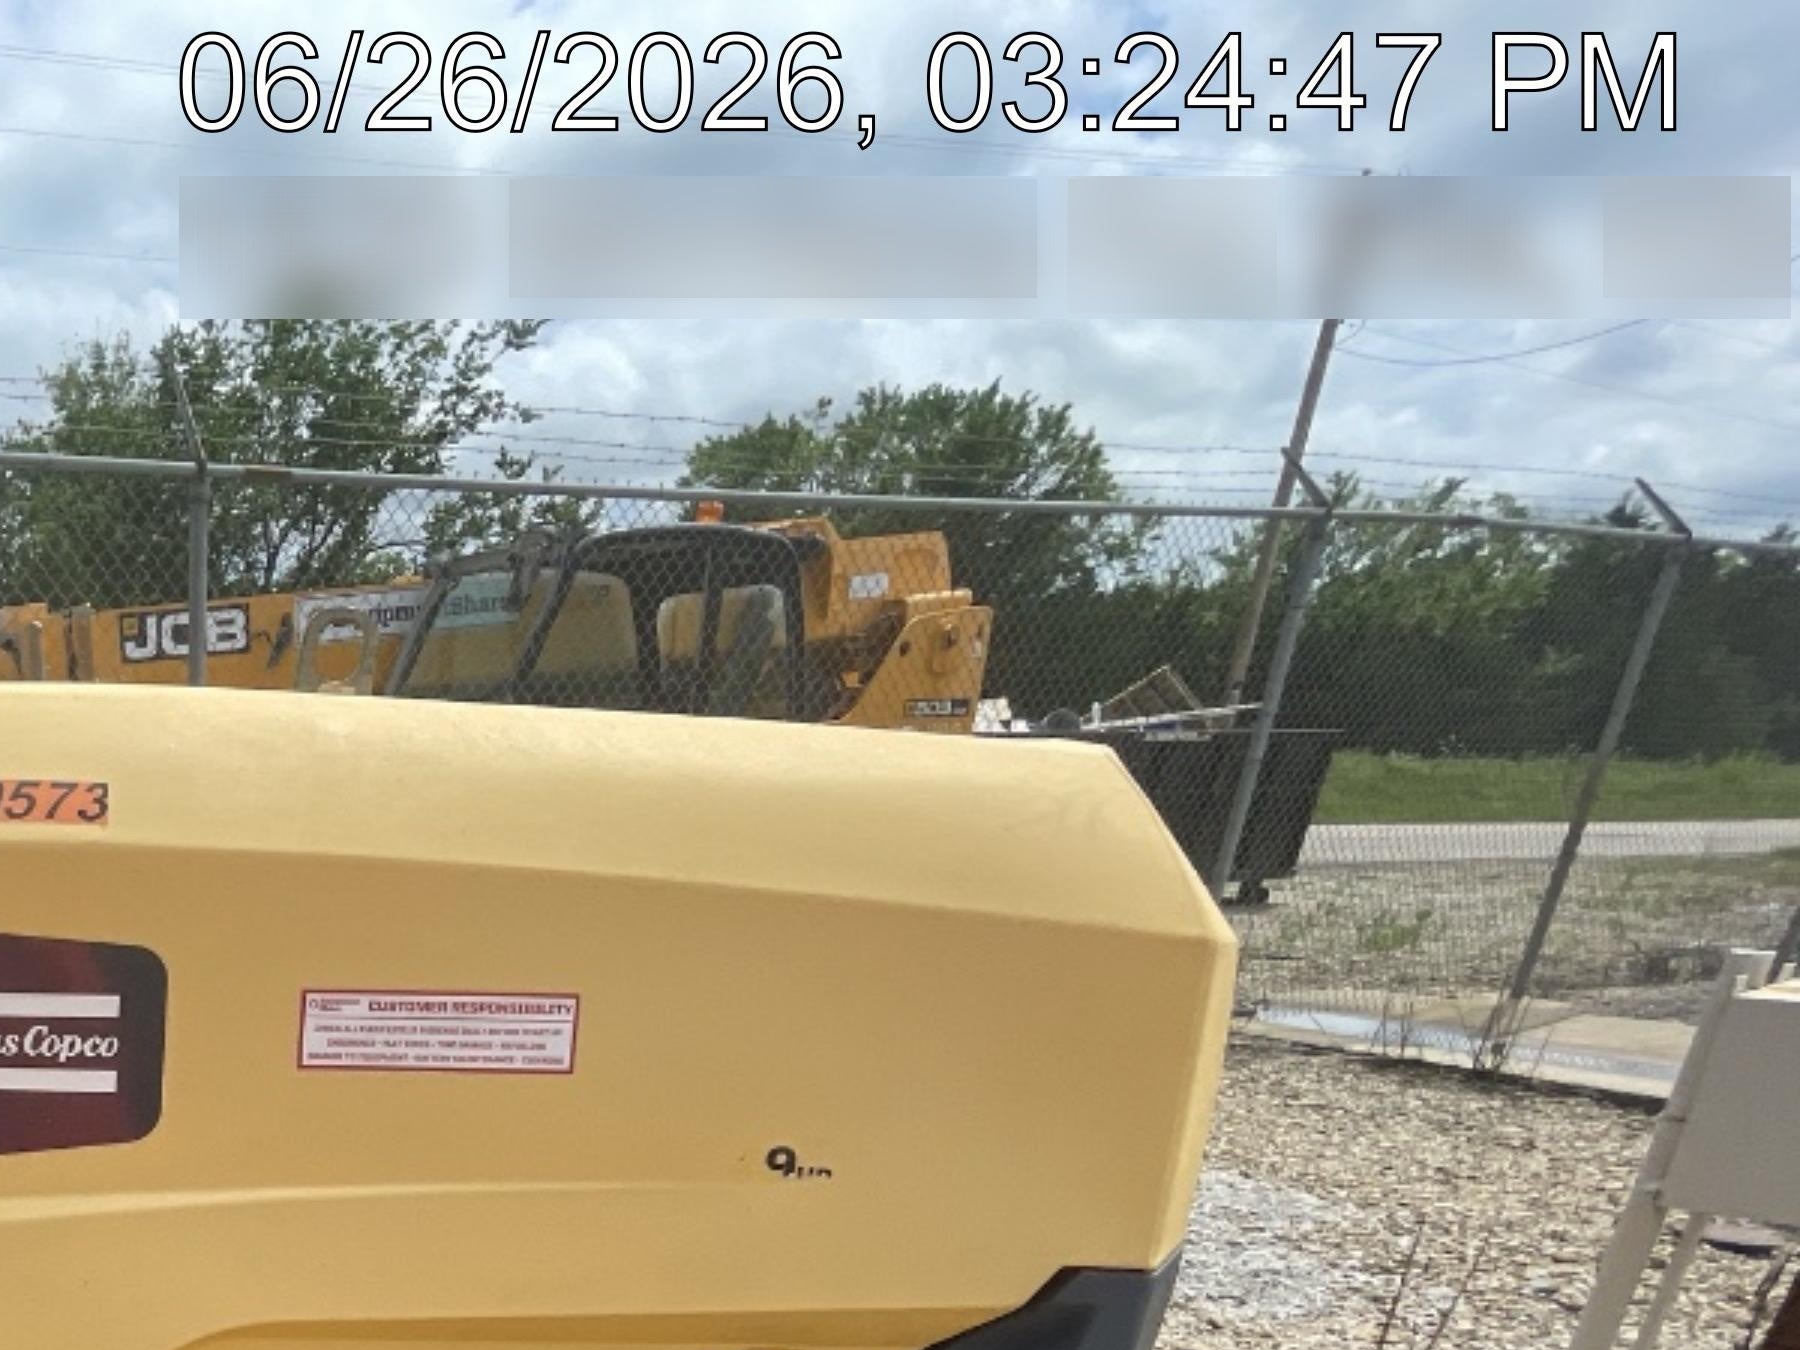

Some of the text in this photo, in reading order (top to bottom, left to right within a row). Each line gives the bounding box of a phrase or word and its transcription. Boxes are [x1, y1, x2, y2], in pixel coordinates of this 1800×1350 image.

[124, 606, 249, 660] JCB
[368, 1000, 448, 1014] CUSTOMER
[23, 1025, 119, 1063] Copco
